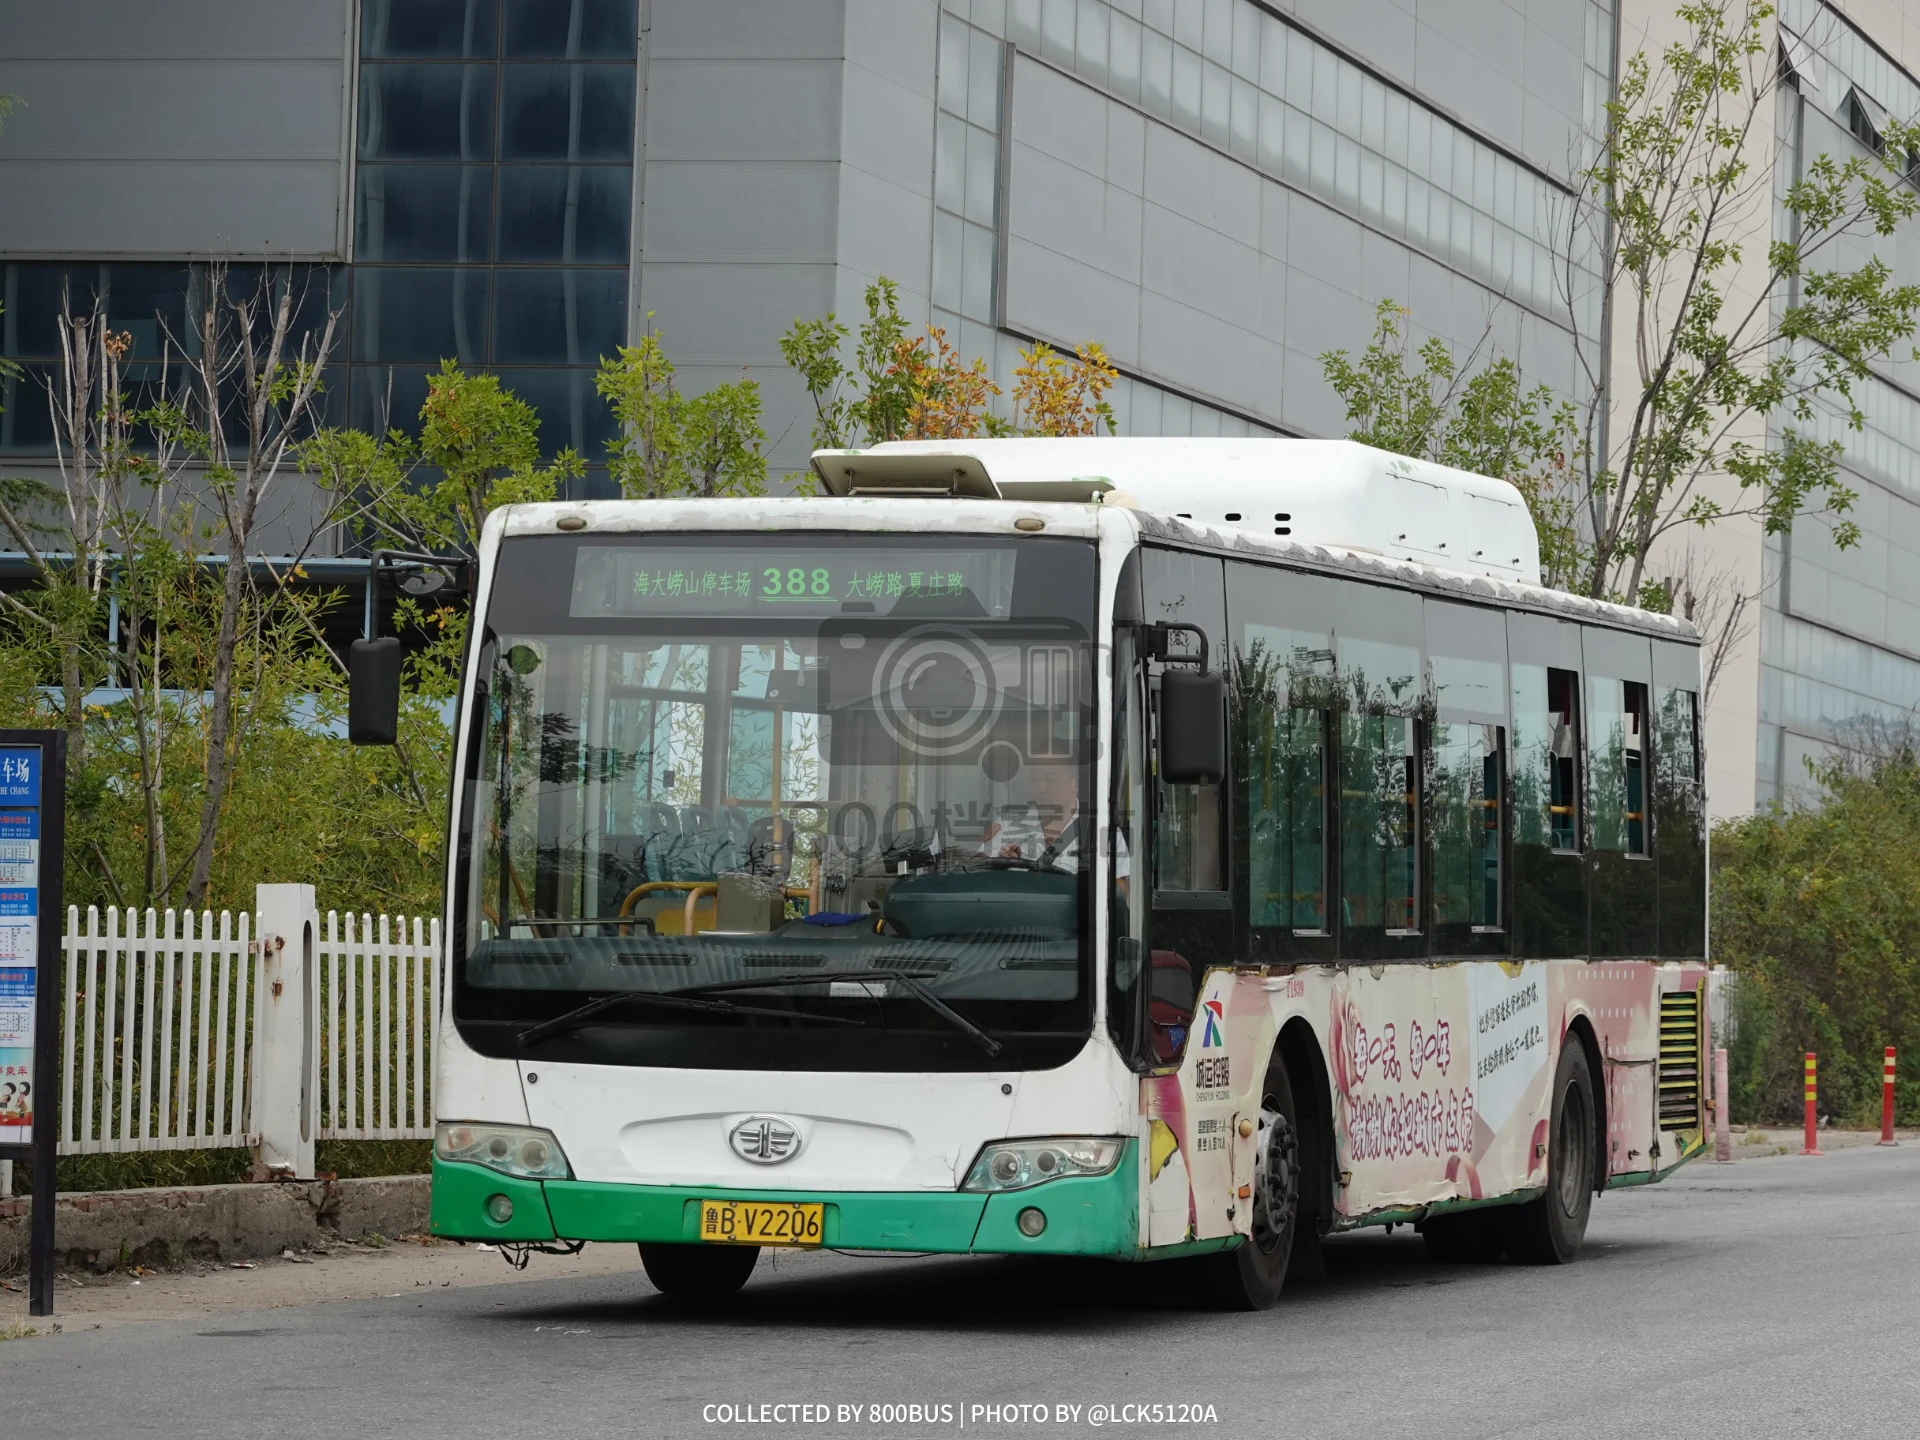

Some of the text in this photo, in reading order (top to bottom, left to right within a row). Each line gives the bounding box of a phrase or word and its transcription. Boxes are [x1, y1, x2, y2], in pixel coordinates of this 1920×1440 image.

[632, 570, 752, 598] 海大崂山停车场
[762, 568, 831, 596] 388
[846, 570, 964, 599] 大崂路夏庄路
[10, 787, 29, 795] CHANG
[0, 1065, 27, 1076] 乘车
[1196, 1057, 1229, 1089] 城运控股
[1350, 1088, 1473, 1162] 谢谢你把城市点亮
[705, 1207, 819, 1237] 鲁B·V2206
